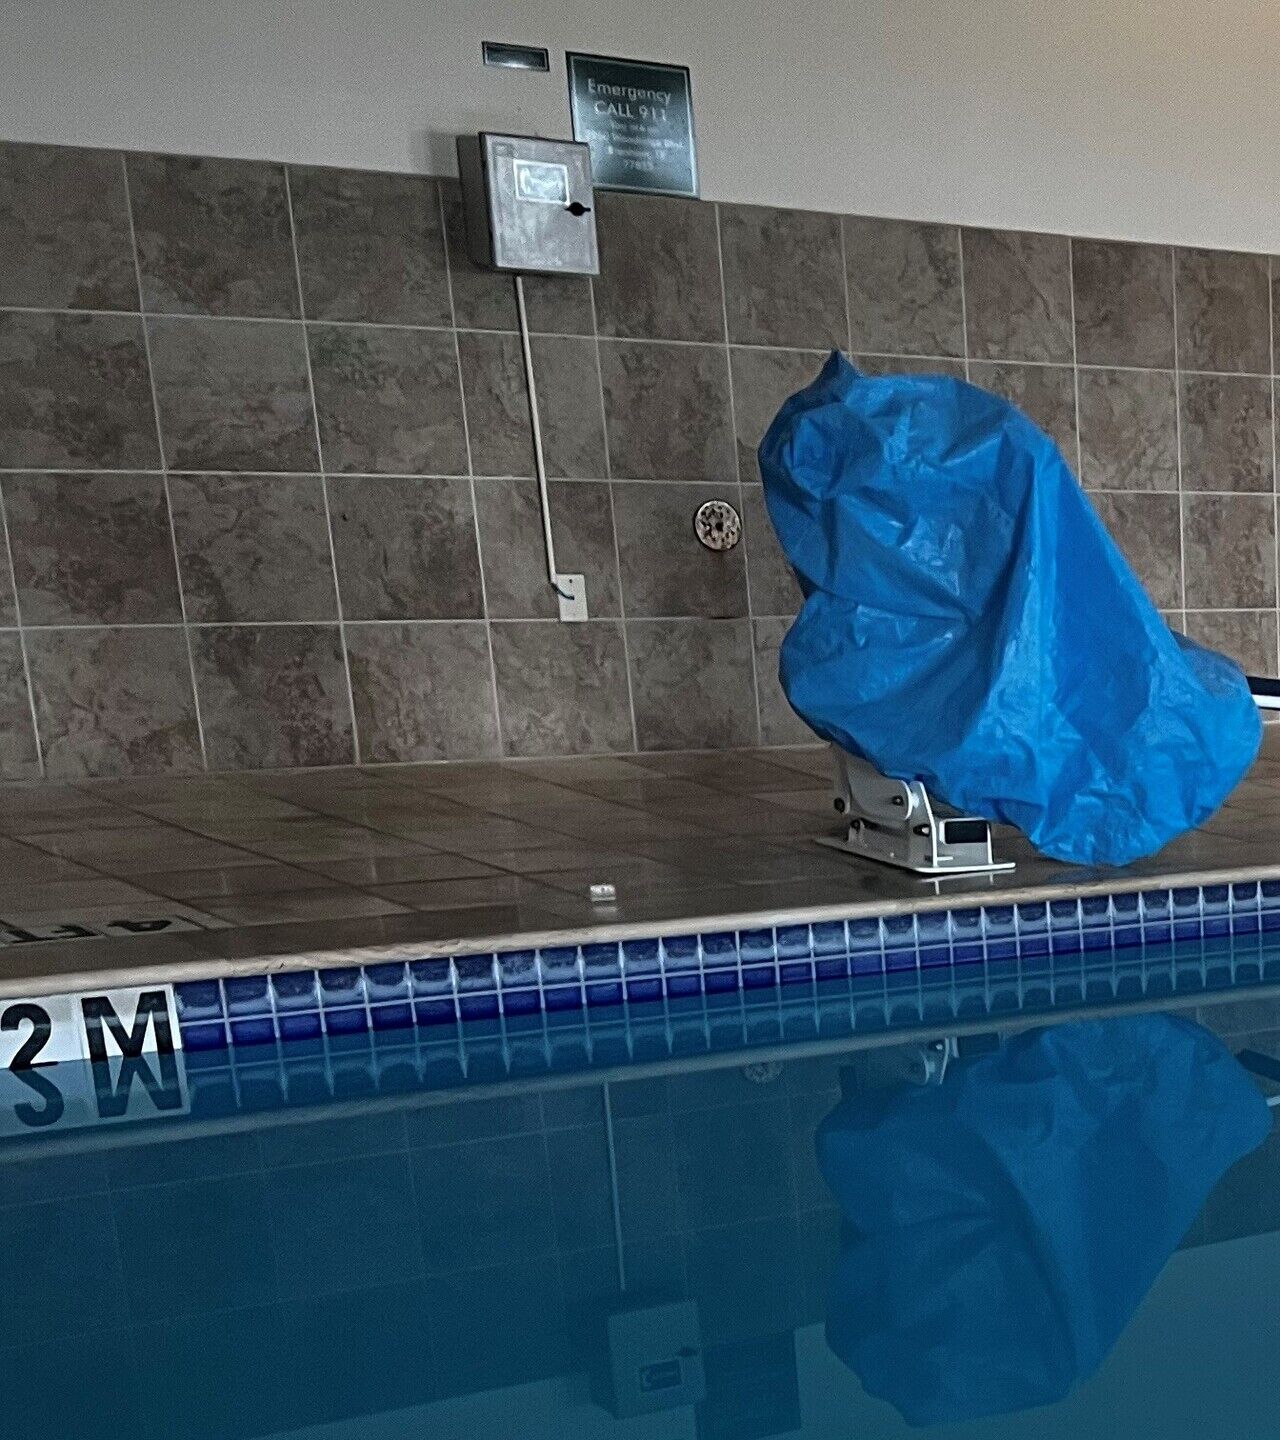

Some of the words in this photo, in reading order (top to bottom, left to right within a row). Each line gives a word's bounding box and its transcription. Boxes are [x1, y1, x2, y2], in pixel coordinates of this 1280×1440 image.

[588, 78, 671, 105] Emergency
[594, 100, 634, 119] CALL
[639, 104, 667, 121] 911
